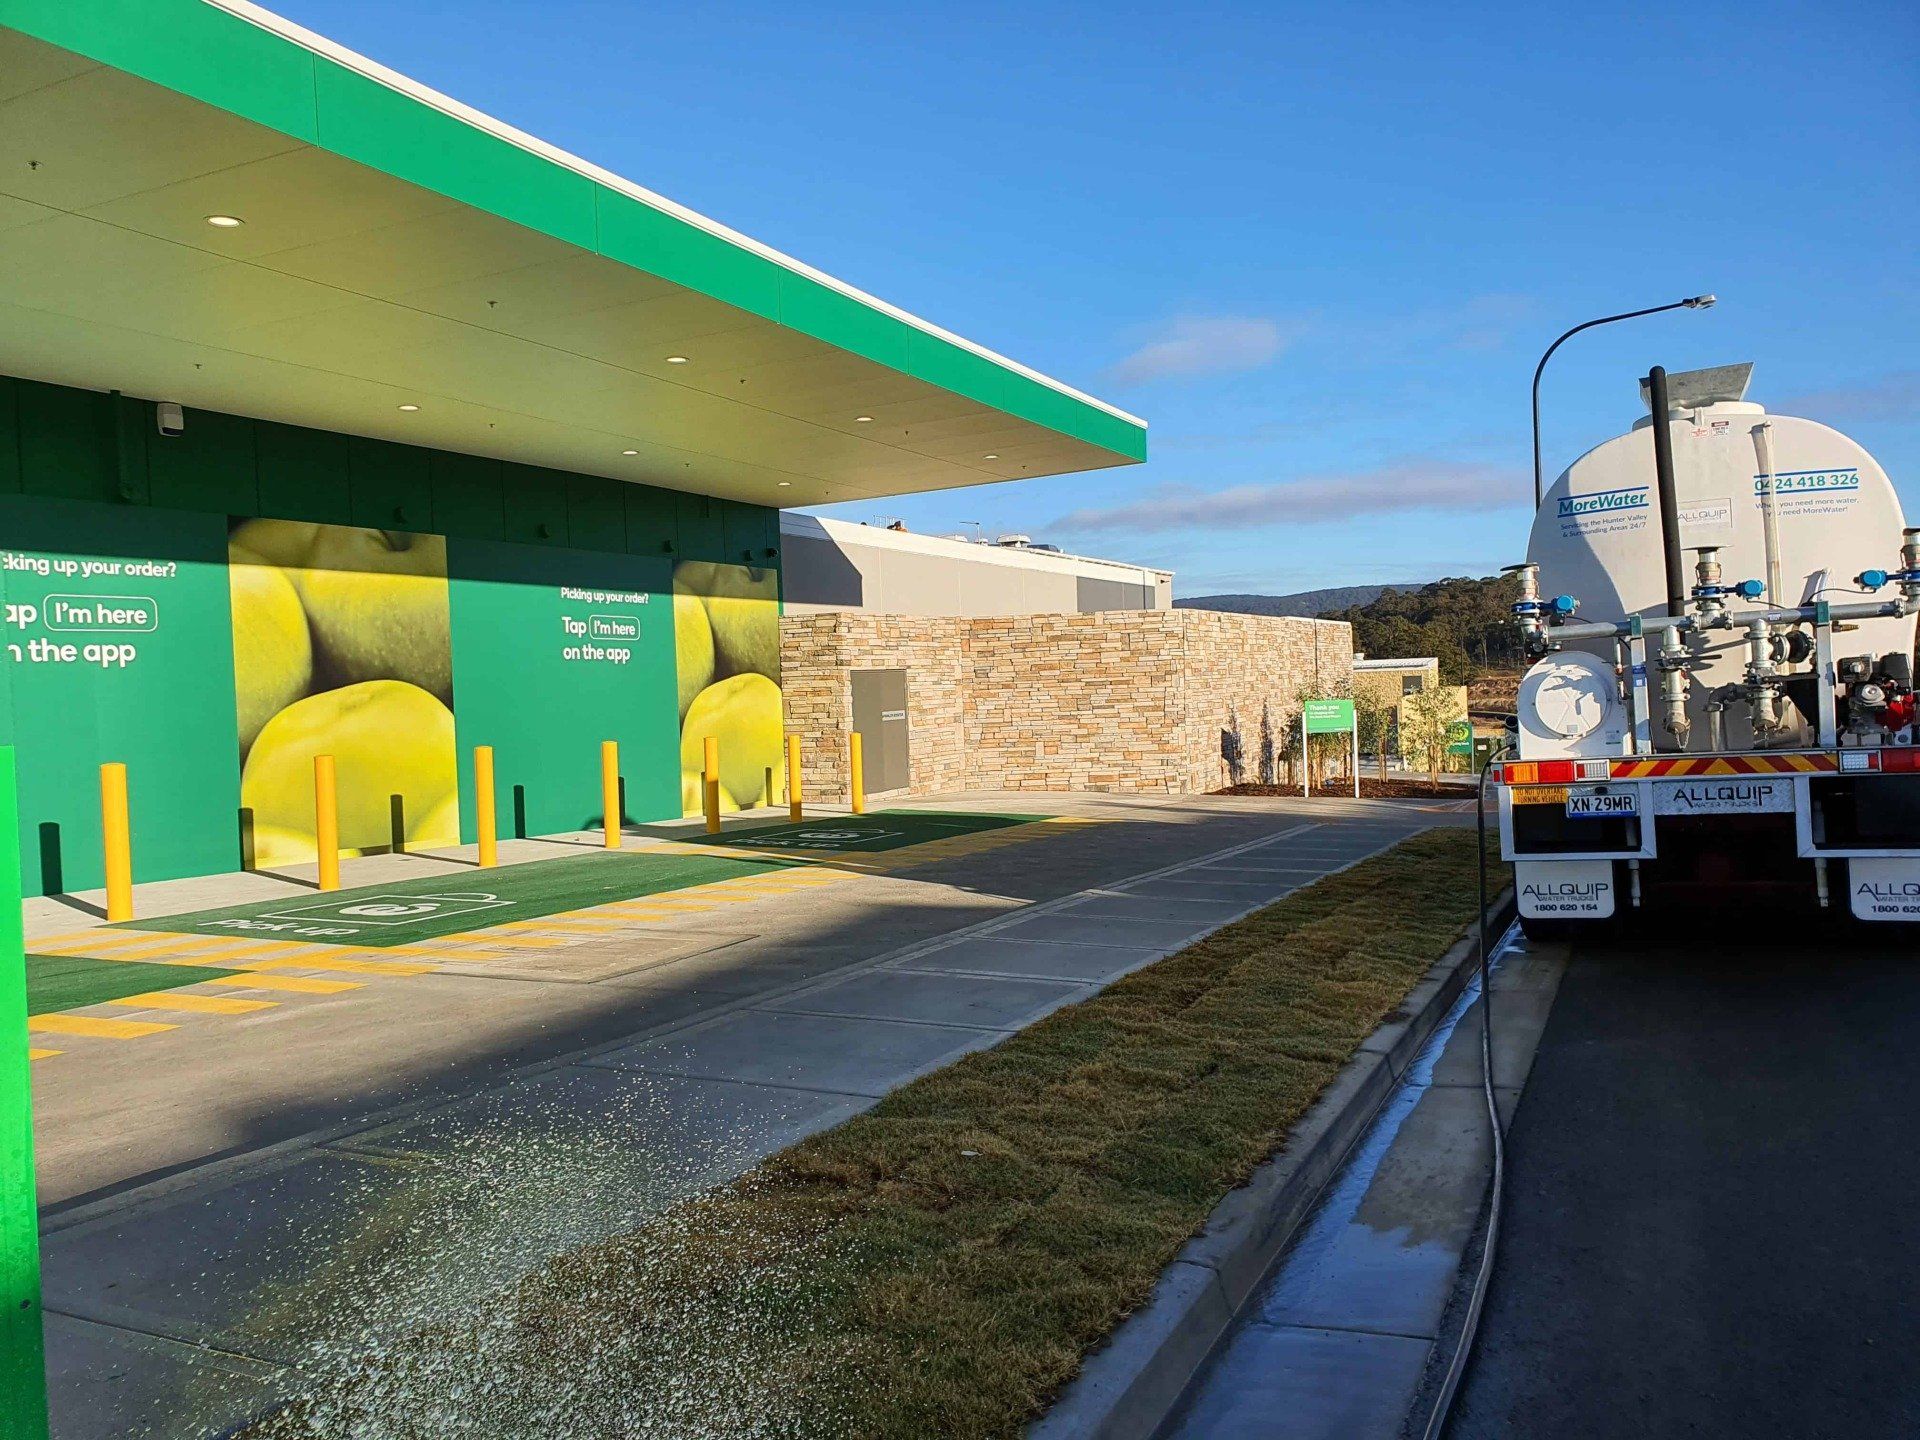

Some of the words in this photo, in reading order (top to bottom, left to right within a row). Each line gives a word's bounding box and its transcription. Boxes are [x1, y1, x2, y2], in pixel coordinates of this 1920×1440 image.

[1797, 475, 1826, 487] 418
[1830, 473, 1859, 485] 326
[1559, 493, 1647, 514] MoreWater
[1783, 508, 1801, 516] need
[1602, 517, 1625, 525] Hunter
[1627, 514, 1648, 522] Valley
[1677, 509, 1728, 523] ALLQUIP
[1569, 527, 1608, 537] Surrounding
[1629, 521, 1647, 530] 24/7
[54, 559, 78, 577] up
[81, 560, 121, 578] your
[124, 561, 177, 577] order?
[560, 587, 592, 603] Picking
[594, 591, 605, 604] up
[605, 592, 624, 604] your
[624, 592, 649, 604] order?
[55, 602, 92, 623] I'm
[96, 603, 148, 624] here
[561, 616, 587, 638] Tap
[594, 619, 611, 635] I'm
[612, 621, 636, 636] here
[28, 637, 78, 662] the
[83, 644, 136, 668] app
[563, 646, 580, 660] on
[582, 643, 605, 660] the
[606, 647, 631, 665] app
[1673, 785, 1773, 808] ALLQUIP
[1522, 883, 1609, 901] ALLQUIP
[1534, 904, 1558, 912] 1800
[1580, 903, 1598, 911] 154
[1871, 905, 1900, 913] 1800
